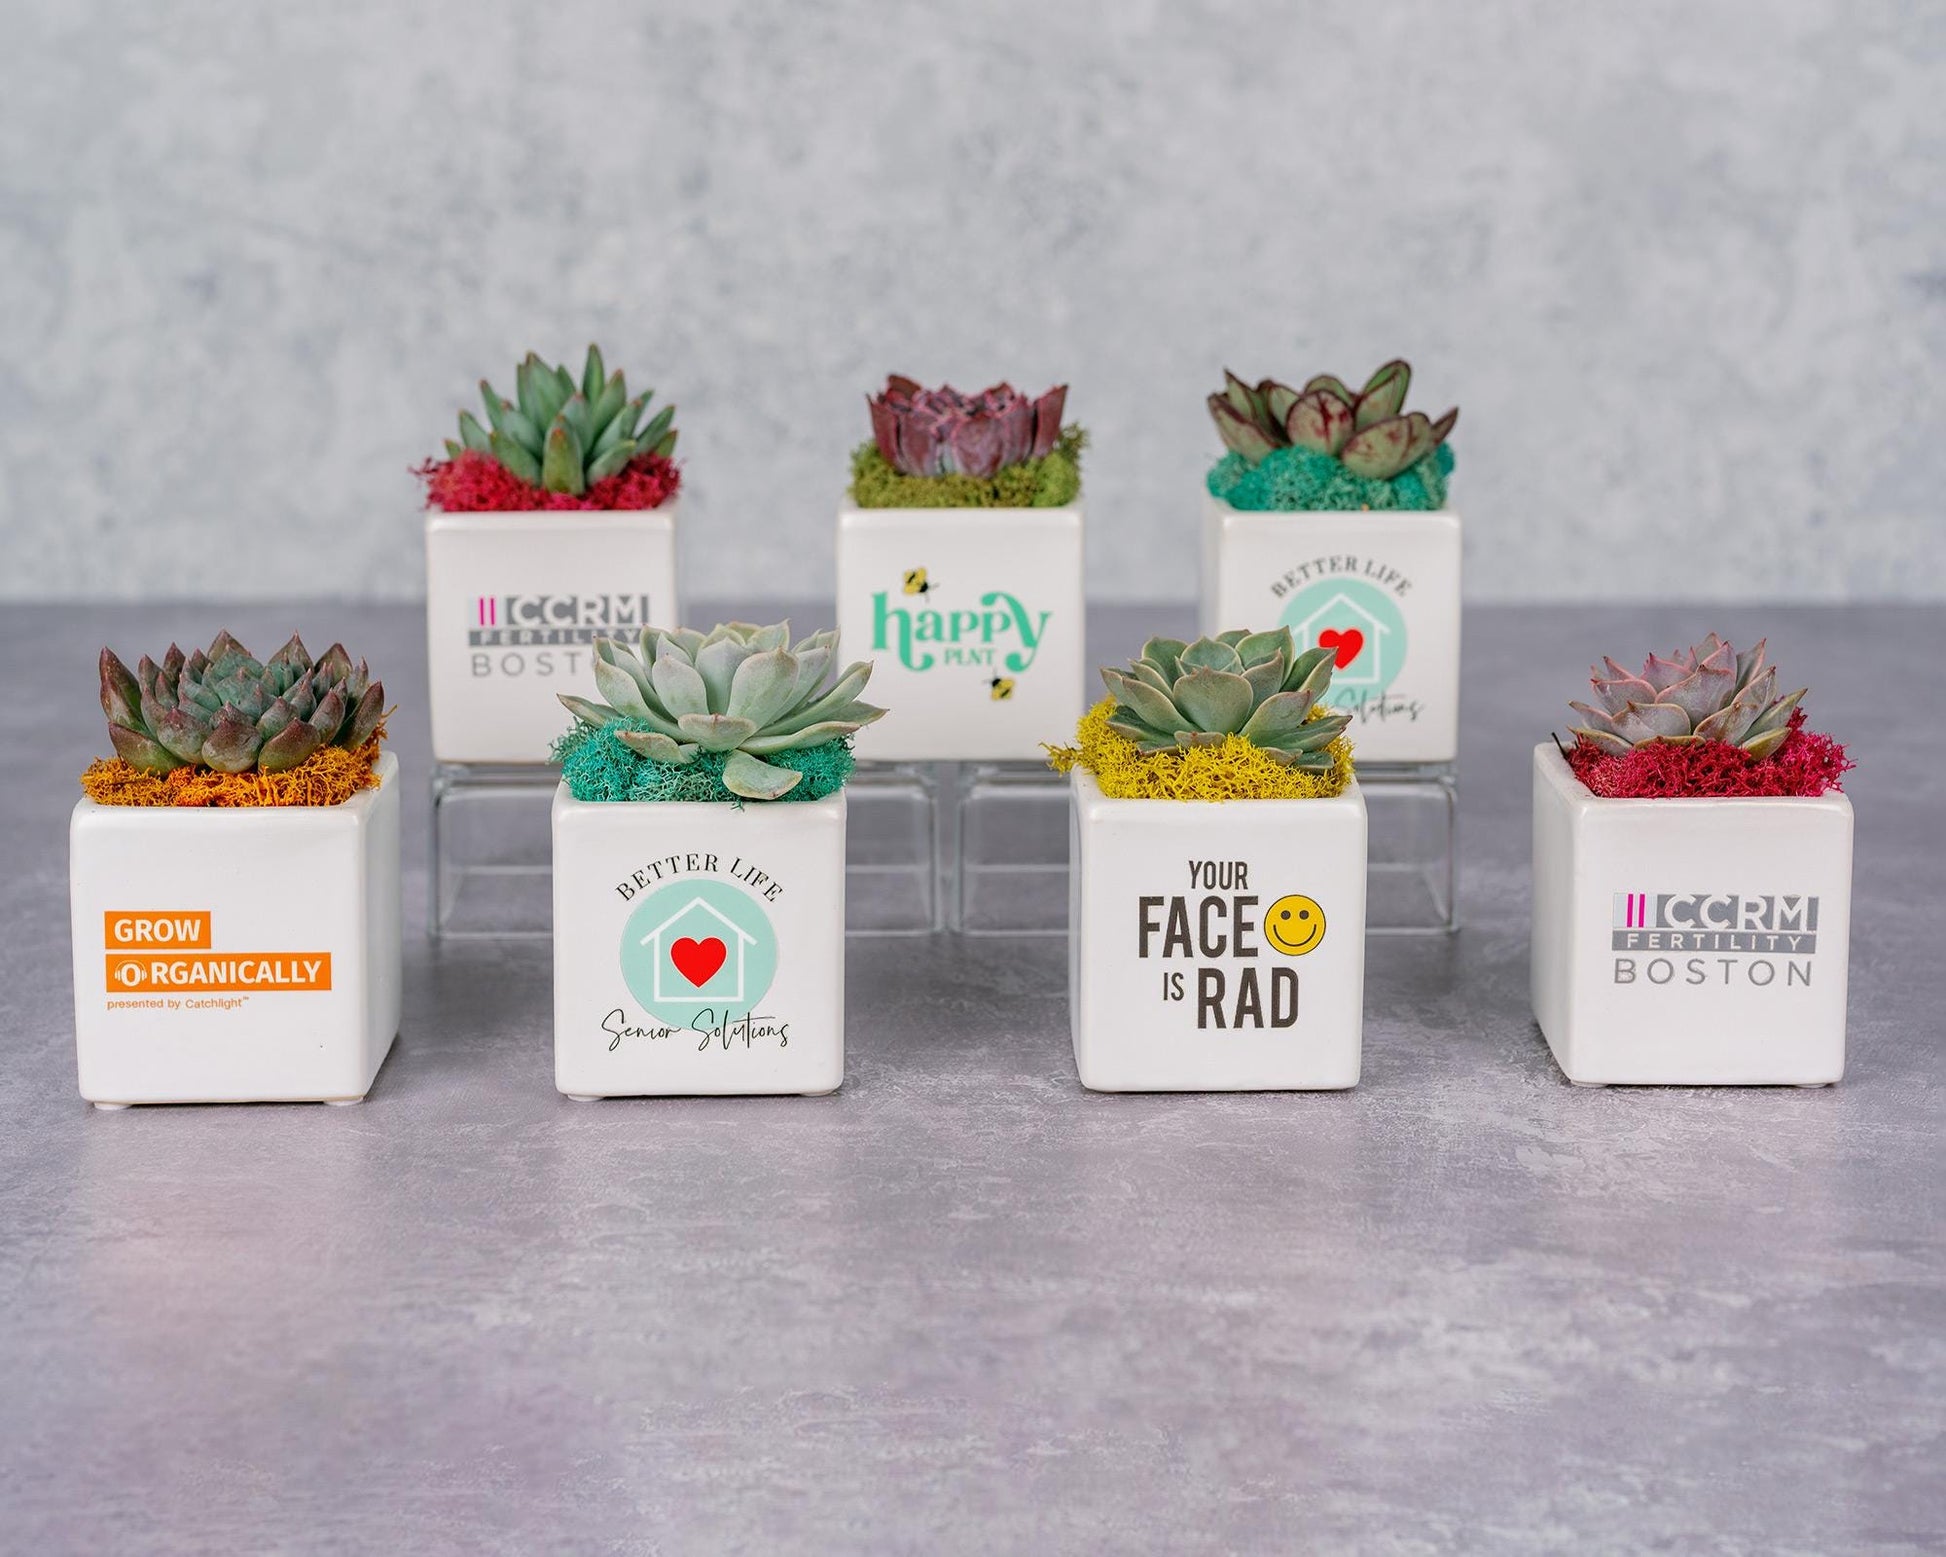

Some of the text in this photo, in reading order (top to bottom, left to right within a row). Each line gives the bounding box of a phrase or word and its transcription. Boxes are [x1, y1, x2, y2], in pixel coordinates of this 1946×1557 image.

[1270, 555, 1413, 599] BETTER LIFE
[511, 595, 642, 626] CCRM
[872, 591, 1053, 673] happy
[471, 653, 596, 677] BOST
[944, 649, 996, 666] PLNT
[615, 853, 783, 902] BETTER LIFE
[1188, 860, 1248, 890] YOUR
[1138, 895, 1259, 958] FACE
[1664, 894, 1809, 931] CCRM
[114, 919, 201, 942] GROW
[1626, 933, 1802, 950] FERTILITY
[120, 960, 322, 986] ORGANICALLY
[1614, 958, 1812, 986] BOSTON
[107, 999, 164, 1010] presented
[168, 999, 181, 1009] by
[1163, 967, 1299, 1029] IS RAD
[601, 1007, 789, 1051] Senior Solutions
